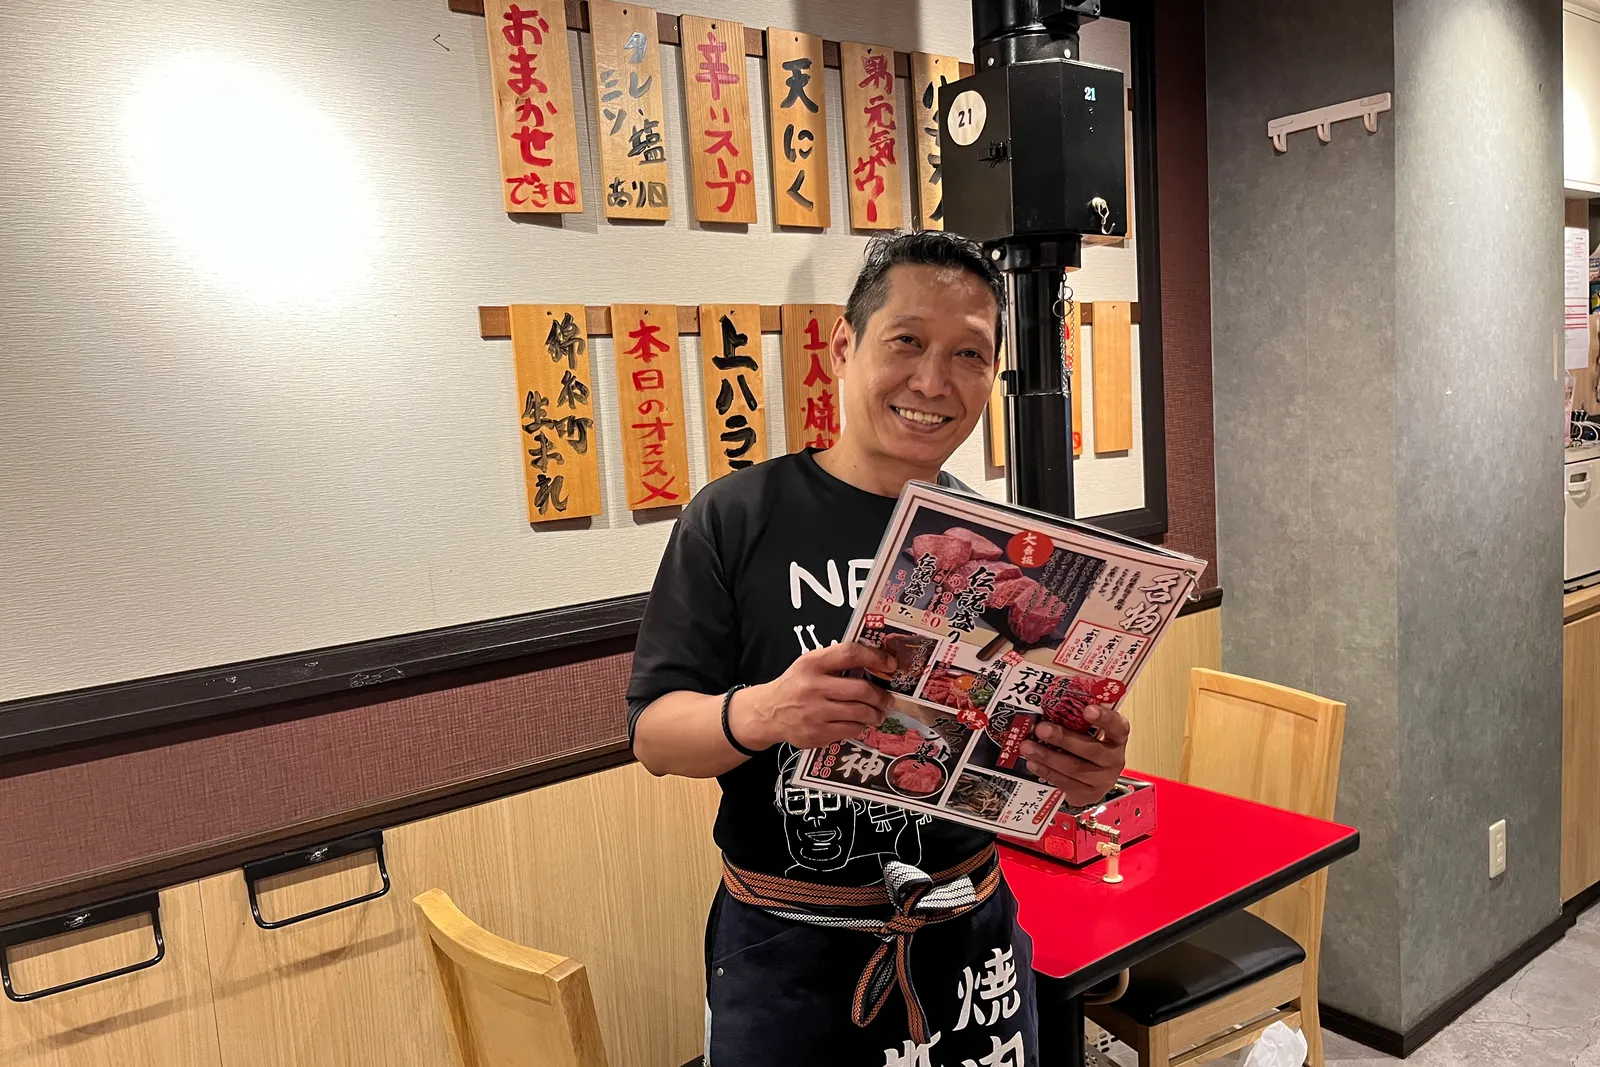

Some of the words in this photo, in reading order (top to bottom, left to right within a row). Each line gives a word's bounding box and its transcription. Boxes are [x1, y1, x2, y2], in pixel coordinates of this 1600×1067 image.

[502, 4, 557, 168] おまかせ
[600, 69, 627, 136] ミソ
[958, 108, 972, 128] 21
[1084, 86, 1097, 101] 21
[695, 32, 752, 213] 辛いスープ
[780, 58, 819, 212] 天にく
[623, 319, 679, 506] 本日のオススメ
[712, 315, 759, 469] 上ハラ
[947, 566, 997, 644] 伝説盛り
[1119, 572, 1180, 635] 名物
[1025, 671, 1055, 707] BBQ
[836, 748, 885, 783] 神
